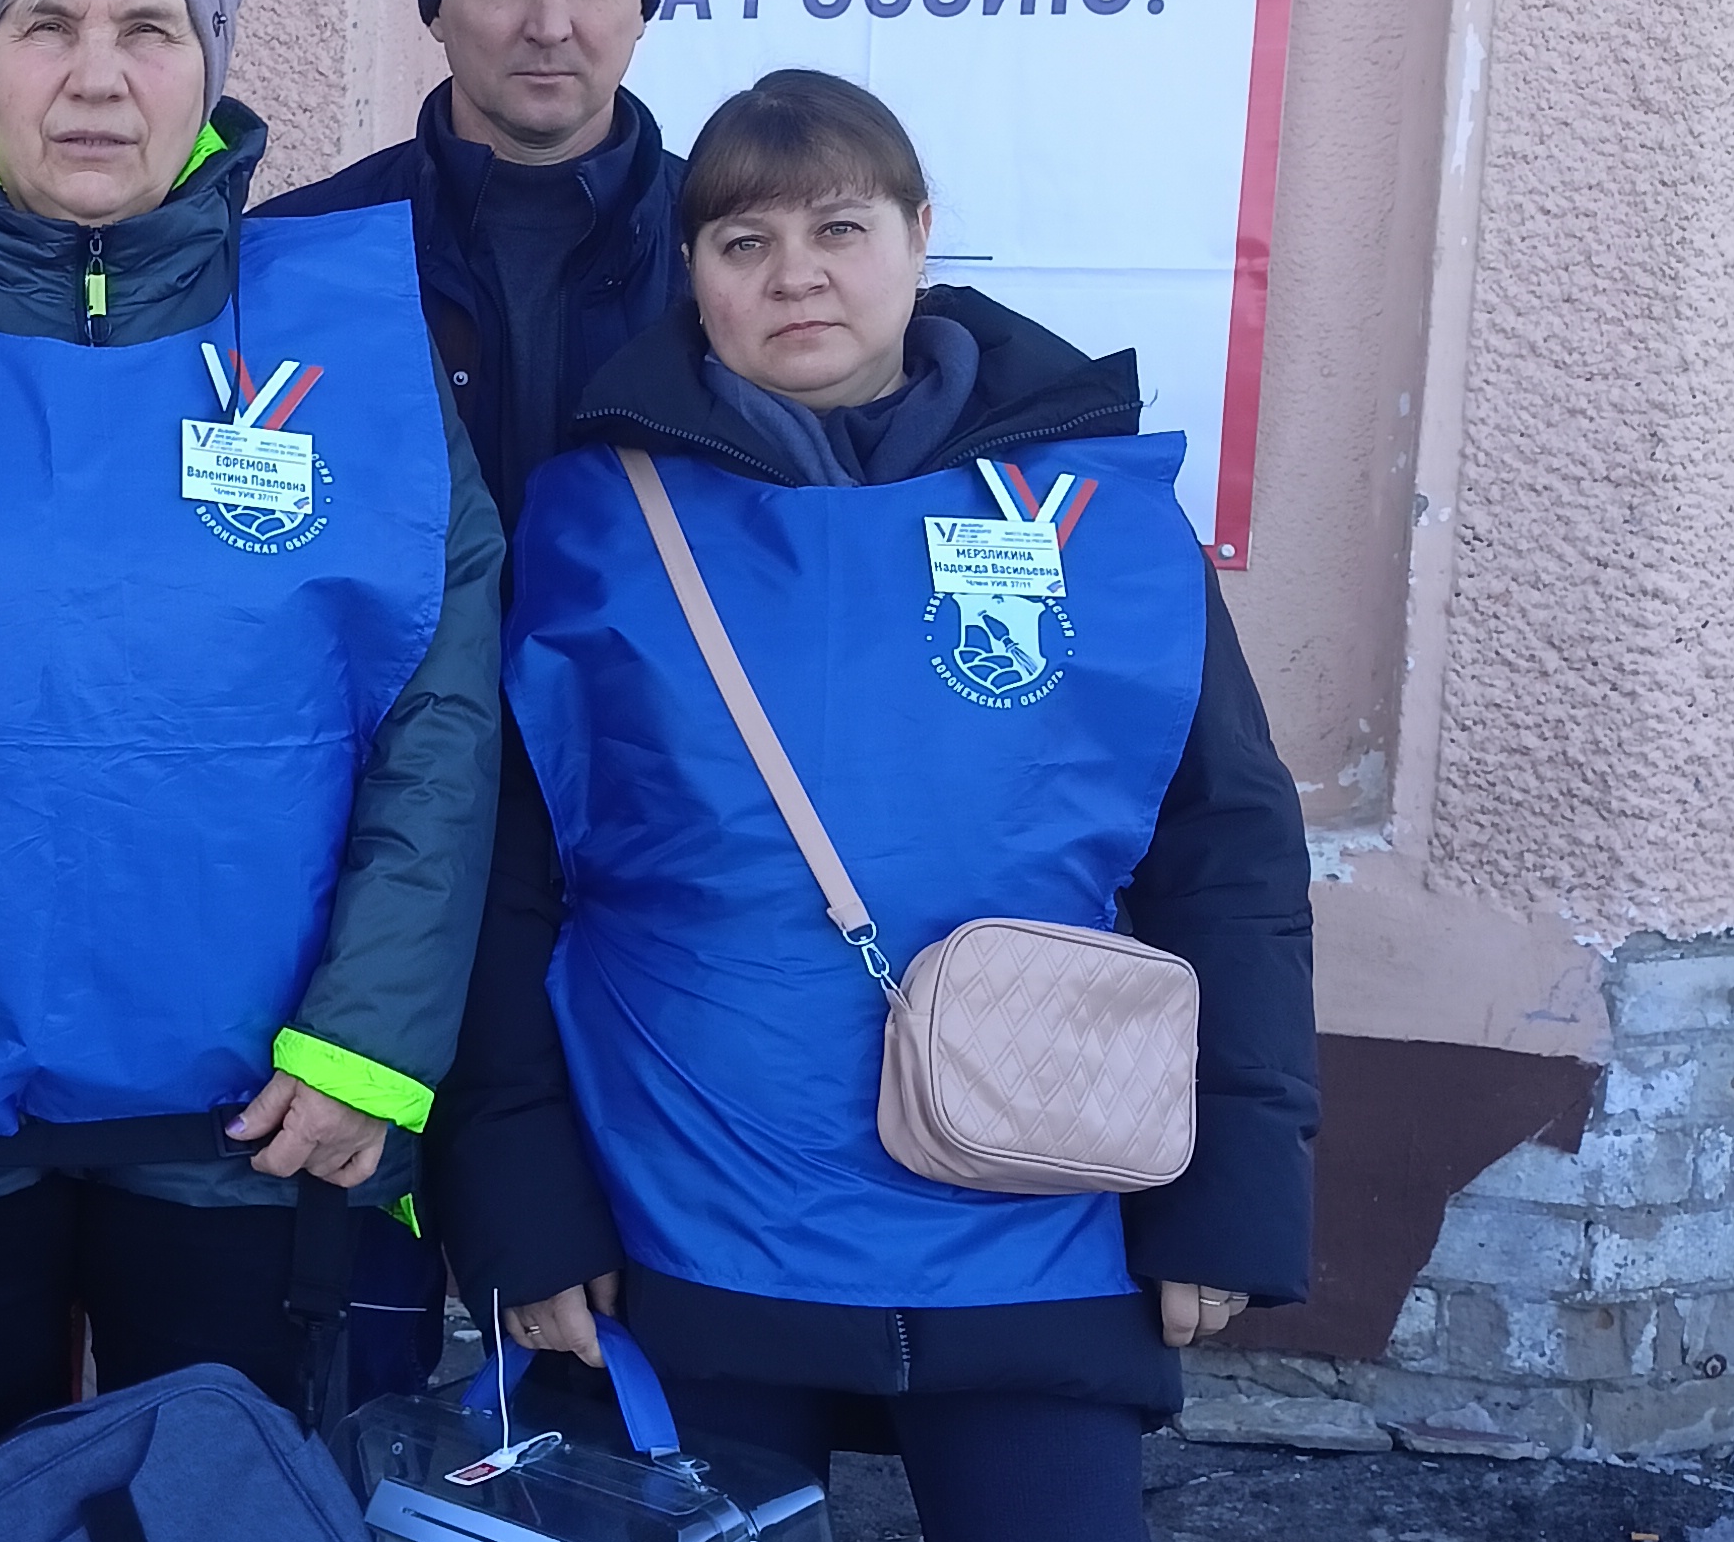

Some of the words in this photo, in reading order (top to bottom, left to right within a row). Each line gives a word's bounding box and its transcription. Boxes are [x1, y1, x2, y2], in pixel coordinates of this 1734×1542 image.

[216, 455, 278, 474] ЕФРЕМОВА
[187, 465, 248, 485] Валентина
[251, 474, 306, 493] Павловна
[196, 505, 278, 554] ВОРОНЕЖСКАЯ
[285, 517, 327, 550] ОБЛАСТЬ
[956, 548, 1034, 561] МЕРЗЛИКИНА
[934, 561, 989, 574] Надежда
[991, 563, 1059, 577] Васильевна
[931, 656, 1012, 709] ВОРОНЕЖСКАЯ
[1020, 670, 1064, 706] ОБЛАСТЬ
